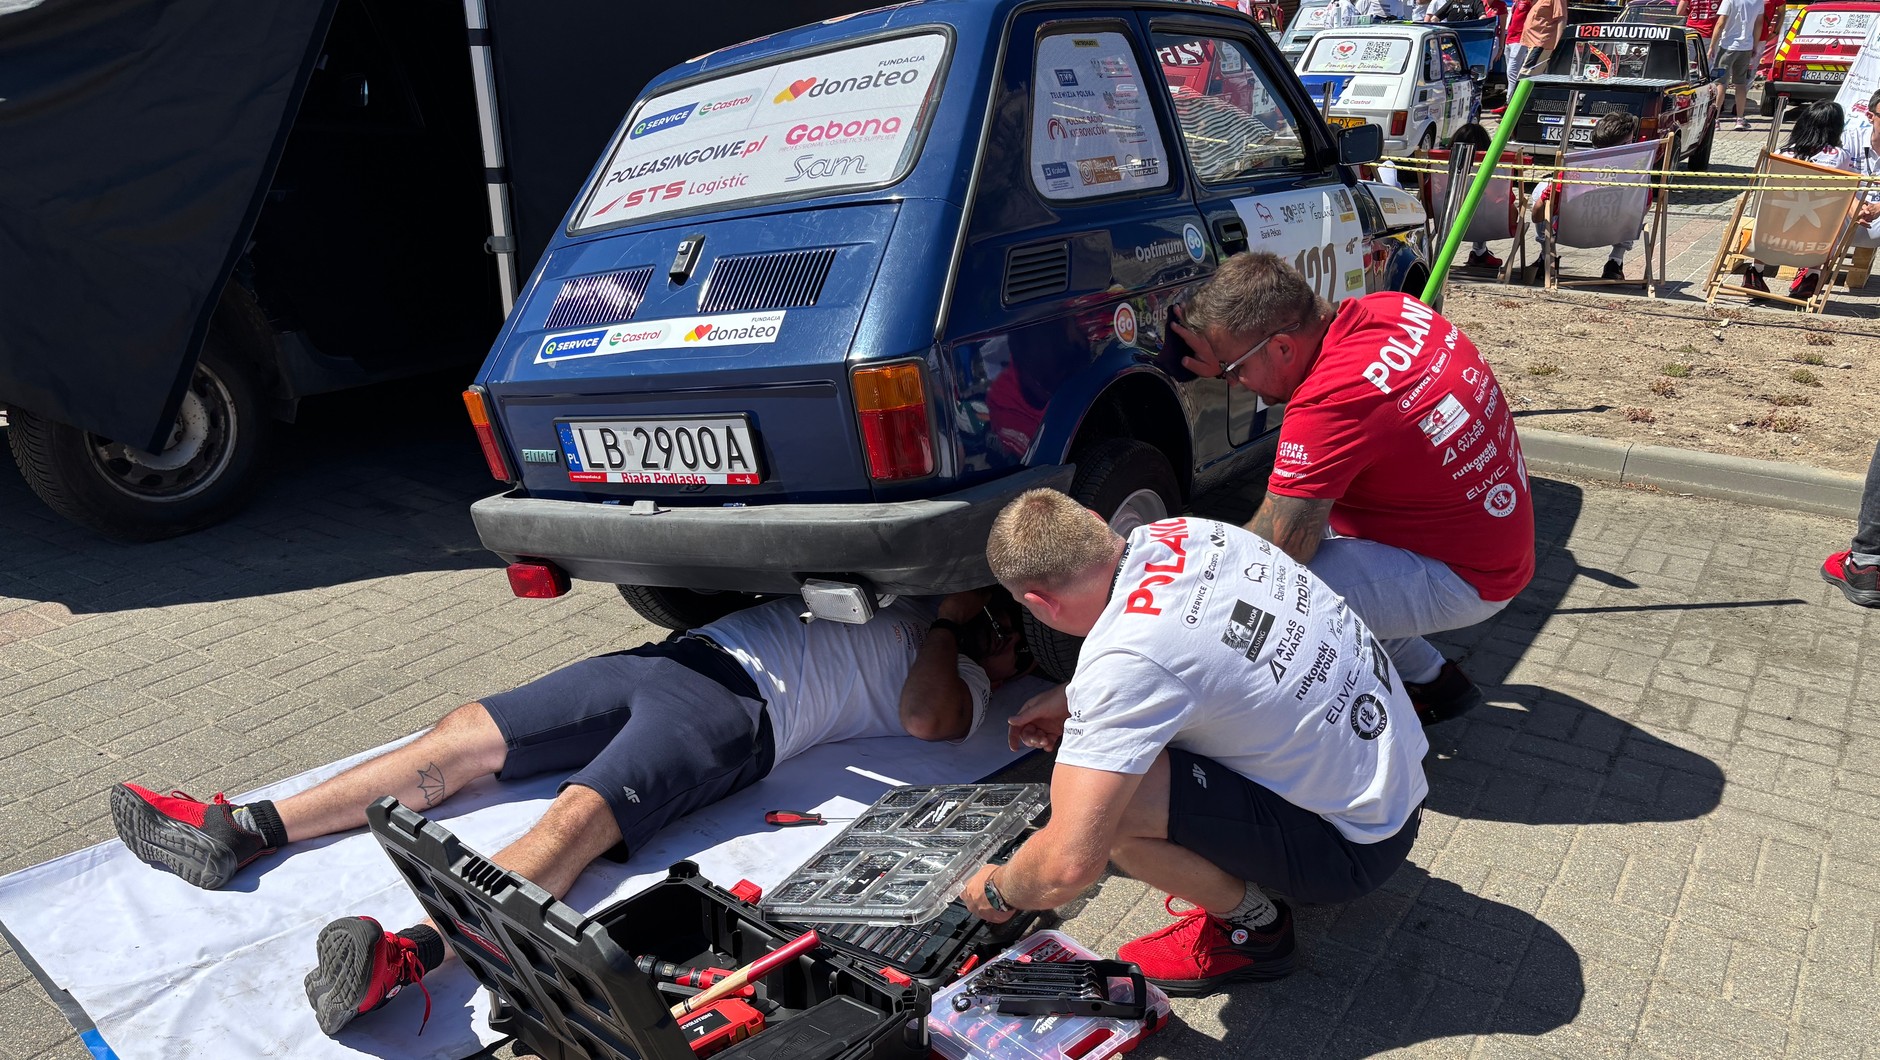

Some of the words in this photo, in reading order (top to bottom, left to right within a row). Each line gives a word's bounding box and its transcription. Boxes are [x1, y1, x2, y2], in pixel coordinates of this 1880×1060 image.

[878, 54, 926, 67] FUNDACJA
[808, 68, 919, 98] donateo
[1077, 90, 1096, 98] POLSKA
[710, 94, 754, 112] Castrol
[646, 109, 689, 131] SERVICE
[784, 116, 902, 146] Gabona
[606, 135, 768, 187] POLEASINGOWE.pl
[623, 179, 687, 209] STS
[688, 172, 750, 196] Logistic
[1135, 241, 1184, 262] Optimum
[751, 315, 781, 323] FUNDACJA
[1140, 305, 1168, 326] Logis
[556, 337, 600, 351] SERVICE
[621, 329, 662, 343] Castrol
[707, 324, 776, 342] donateo
[1362, 296, 1434, 395] POLAN
[1408, 375, 1432, 402] SERVICE
[1457, 419, 1482, 448] ATLAS
[1459, 425, 1486, 452] WARD
[567, 453, 580, 465] PL
[578, 427, 625, 470] LB
[632, 425, 751, 471] 2900A
[1280, 441, 1304, 453] STARS
[1452, 439, 1495, 480] rutkowski
[1476, 446, 1498, 472] group
[621, 472, 650, 484] Biała
[654, 472, 707, 485] Podlaska
[1277, 565, 1287, 583] Pekao
[1191, 585, 1208, 615] SERVICE
[1274, 581, 1286, 602] Bank
[1249, 630, 1266, 658] LEASING
[1276, 619, 1297, 658] ATLAS
[1283, 624, 1306, 662] WARD
[1295, 640, 1331, 701] rutkowski
[1317, 647, 1338, 684] group
